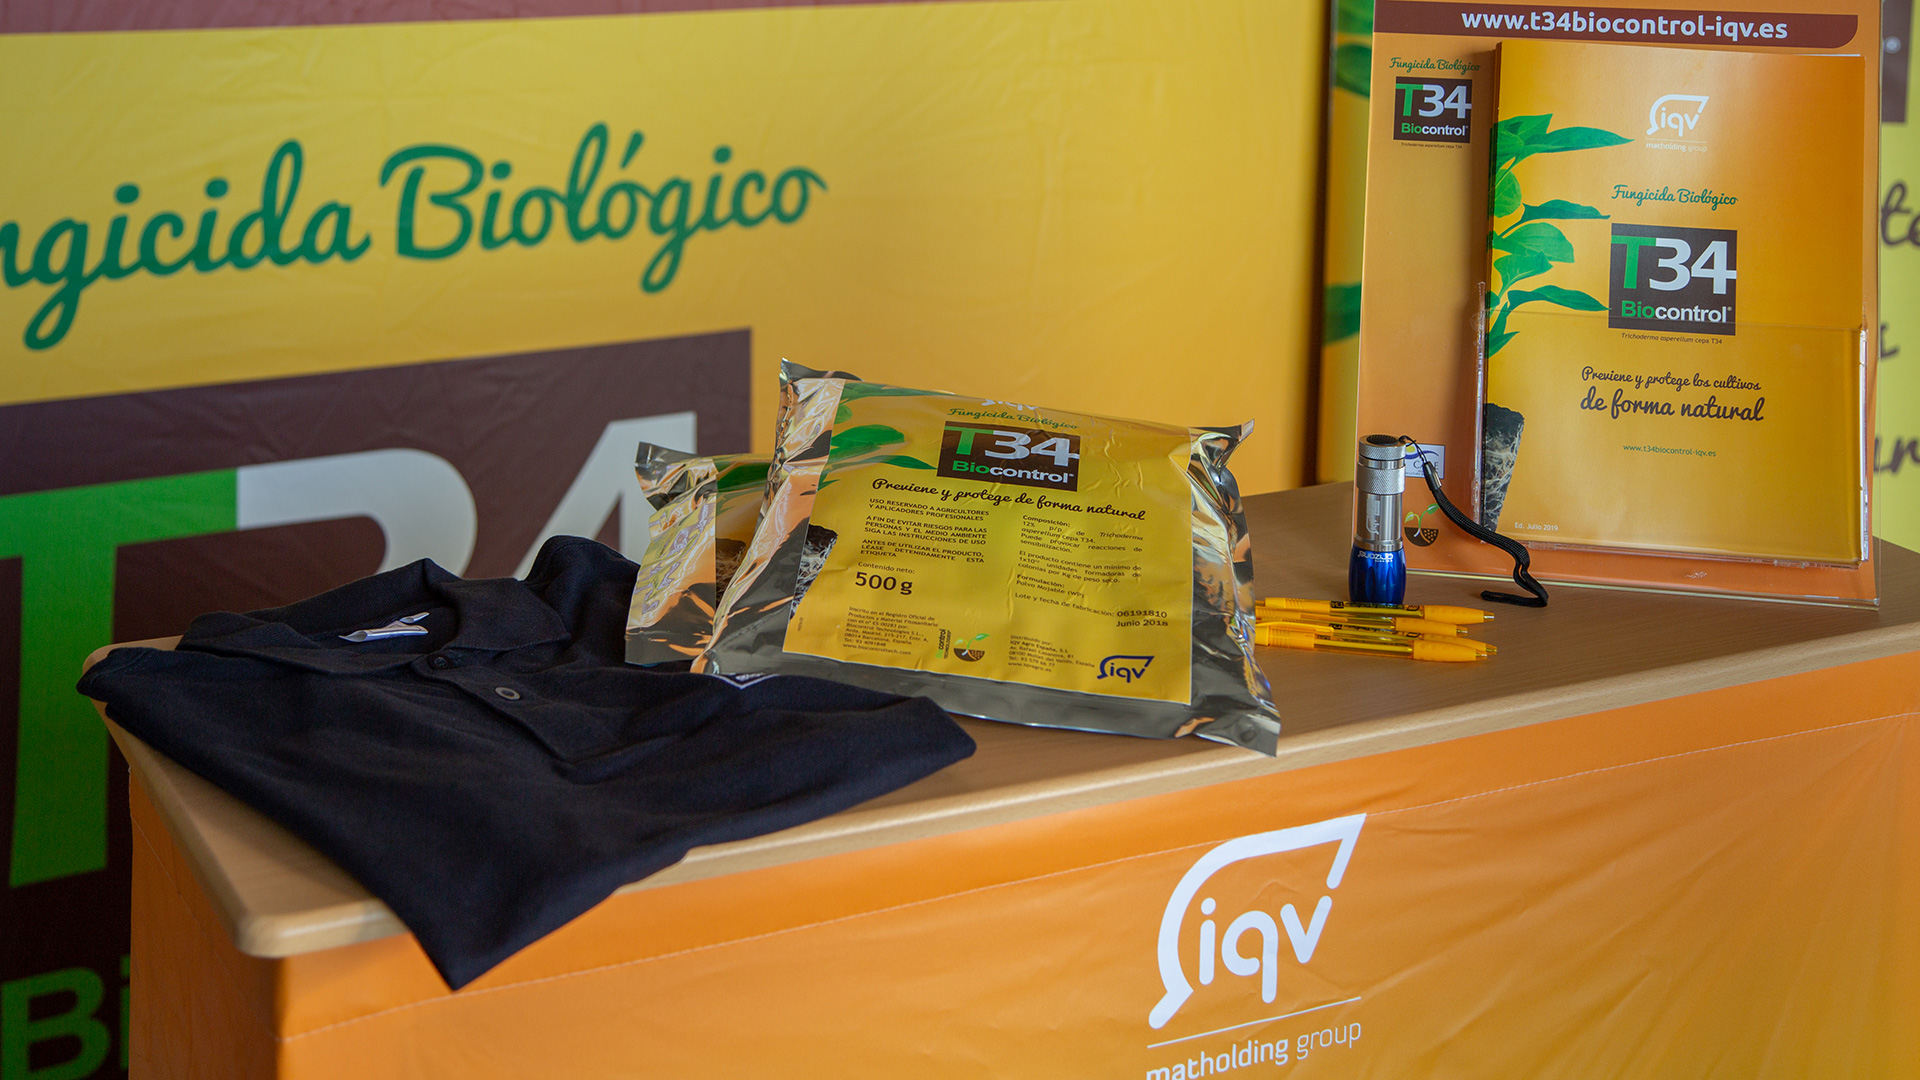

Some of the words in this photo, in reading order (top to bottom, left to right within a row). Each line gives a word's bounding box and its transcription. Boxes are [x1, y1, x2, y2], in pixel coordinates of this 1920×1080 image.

[1461, 10, 1788, 42] www.t34biocontrol-iqv.es
[1389, 57, 1436, 73] Fungicida
[1437, 59, 1481, 75] Biológico
[1396, 83, 1472, 119] T34
[1661, 107, 1699, 137] iqv
[1646, 143, 1686, 152] matholding
[1611, 184, 1676, 207] Fungicida
[1677, 188, 1739, 211] Biológico
[380, 122, 828, 294] Biológico
[1611, 235, 1737, 294] T34
[1582, 366, 1633, 383] Previene
[1635, 374, 1643, 389] y
[1645, 371, 1691, 391] protege
[1693, 373, 1711, 387] los
[1713, 375, 1761, 390] cultivos
[1580, 386, 1607, 411] de
[1610, 388, 1675, 419] forma
[1681, 395, 1765, 421] natural
[948, 408, 1015, 419] Fungicida
[1016, 414, 1079, 429] Biológico
[944, 426, 1080, 466] T34
[1623, 444, 1716, 457] www.t34biocontrol-iqv.es
[872, 478, 938, 495] Previene
[941, 489, 951, 500] y
[953, 489, 1012, 509] protege
[1015, 493, 1034, 504] de
[1037, 497, 1083, 512] forma
[1086, 504, 1145, 520] natural
[875, 504, 924, 515] APLICADORES
[926, 511, 983, 521] PROFESIONALES
[887, 500, 928, 510] RESERVADO
[936, 507, 989, 516] AGRICULTORES
[866, 521, 902, 531] PERSONAS
[1023, 515, 1070, 527] Composición:
[899, 532, 956, 543] INSTRUCCIONES
[1021, 528, 1060, 538] asperellum
[1021, 533, 1042, 541] Puede
[1050, 539, 1080, 548] provocar
[1100, 532, 1143, 540] Trichoderma
[895, 547, 956, 560] DETENIDAMENTE
[899, 543, 931, 551] UTILIZAR
[943, 548, 984, 557] PRODUCTO,
[858, 562, 894, 571] Contenido
[1018, 563, 1046, 572] colonias
[1028, 552, 1059, 563] producto
[1061, 560, 1092, 569] contiene
[1047, 563, 1077, 572] unidades
[855, 571, 896, 590] 500
[900, 581, 912, 595] g
[1016, 580, 1036, 588] Polvo
[1037, 584, 1065, 595] Mojable
[1017, 574, 1064, 588] Formulación:
[1040, 596, 1059, 605] fecha
[1110, 662, 1146, 683] iqv
[1199, 896, 1332, 1003] iqv
[1146, 1038, 1288, 1080] matholding
[1296, 1022, 1361, 1060] group
